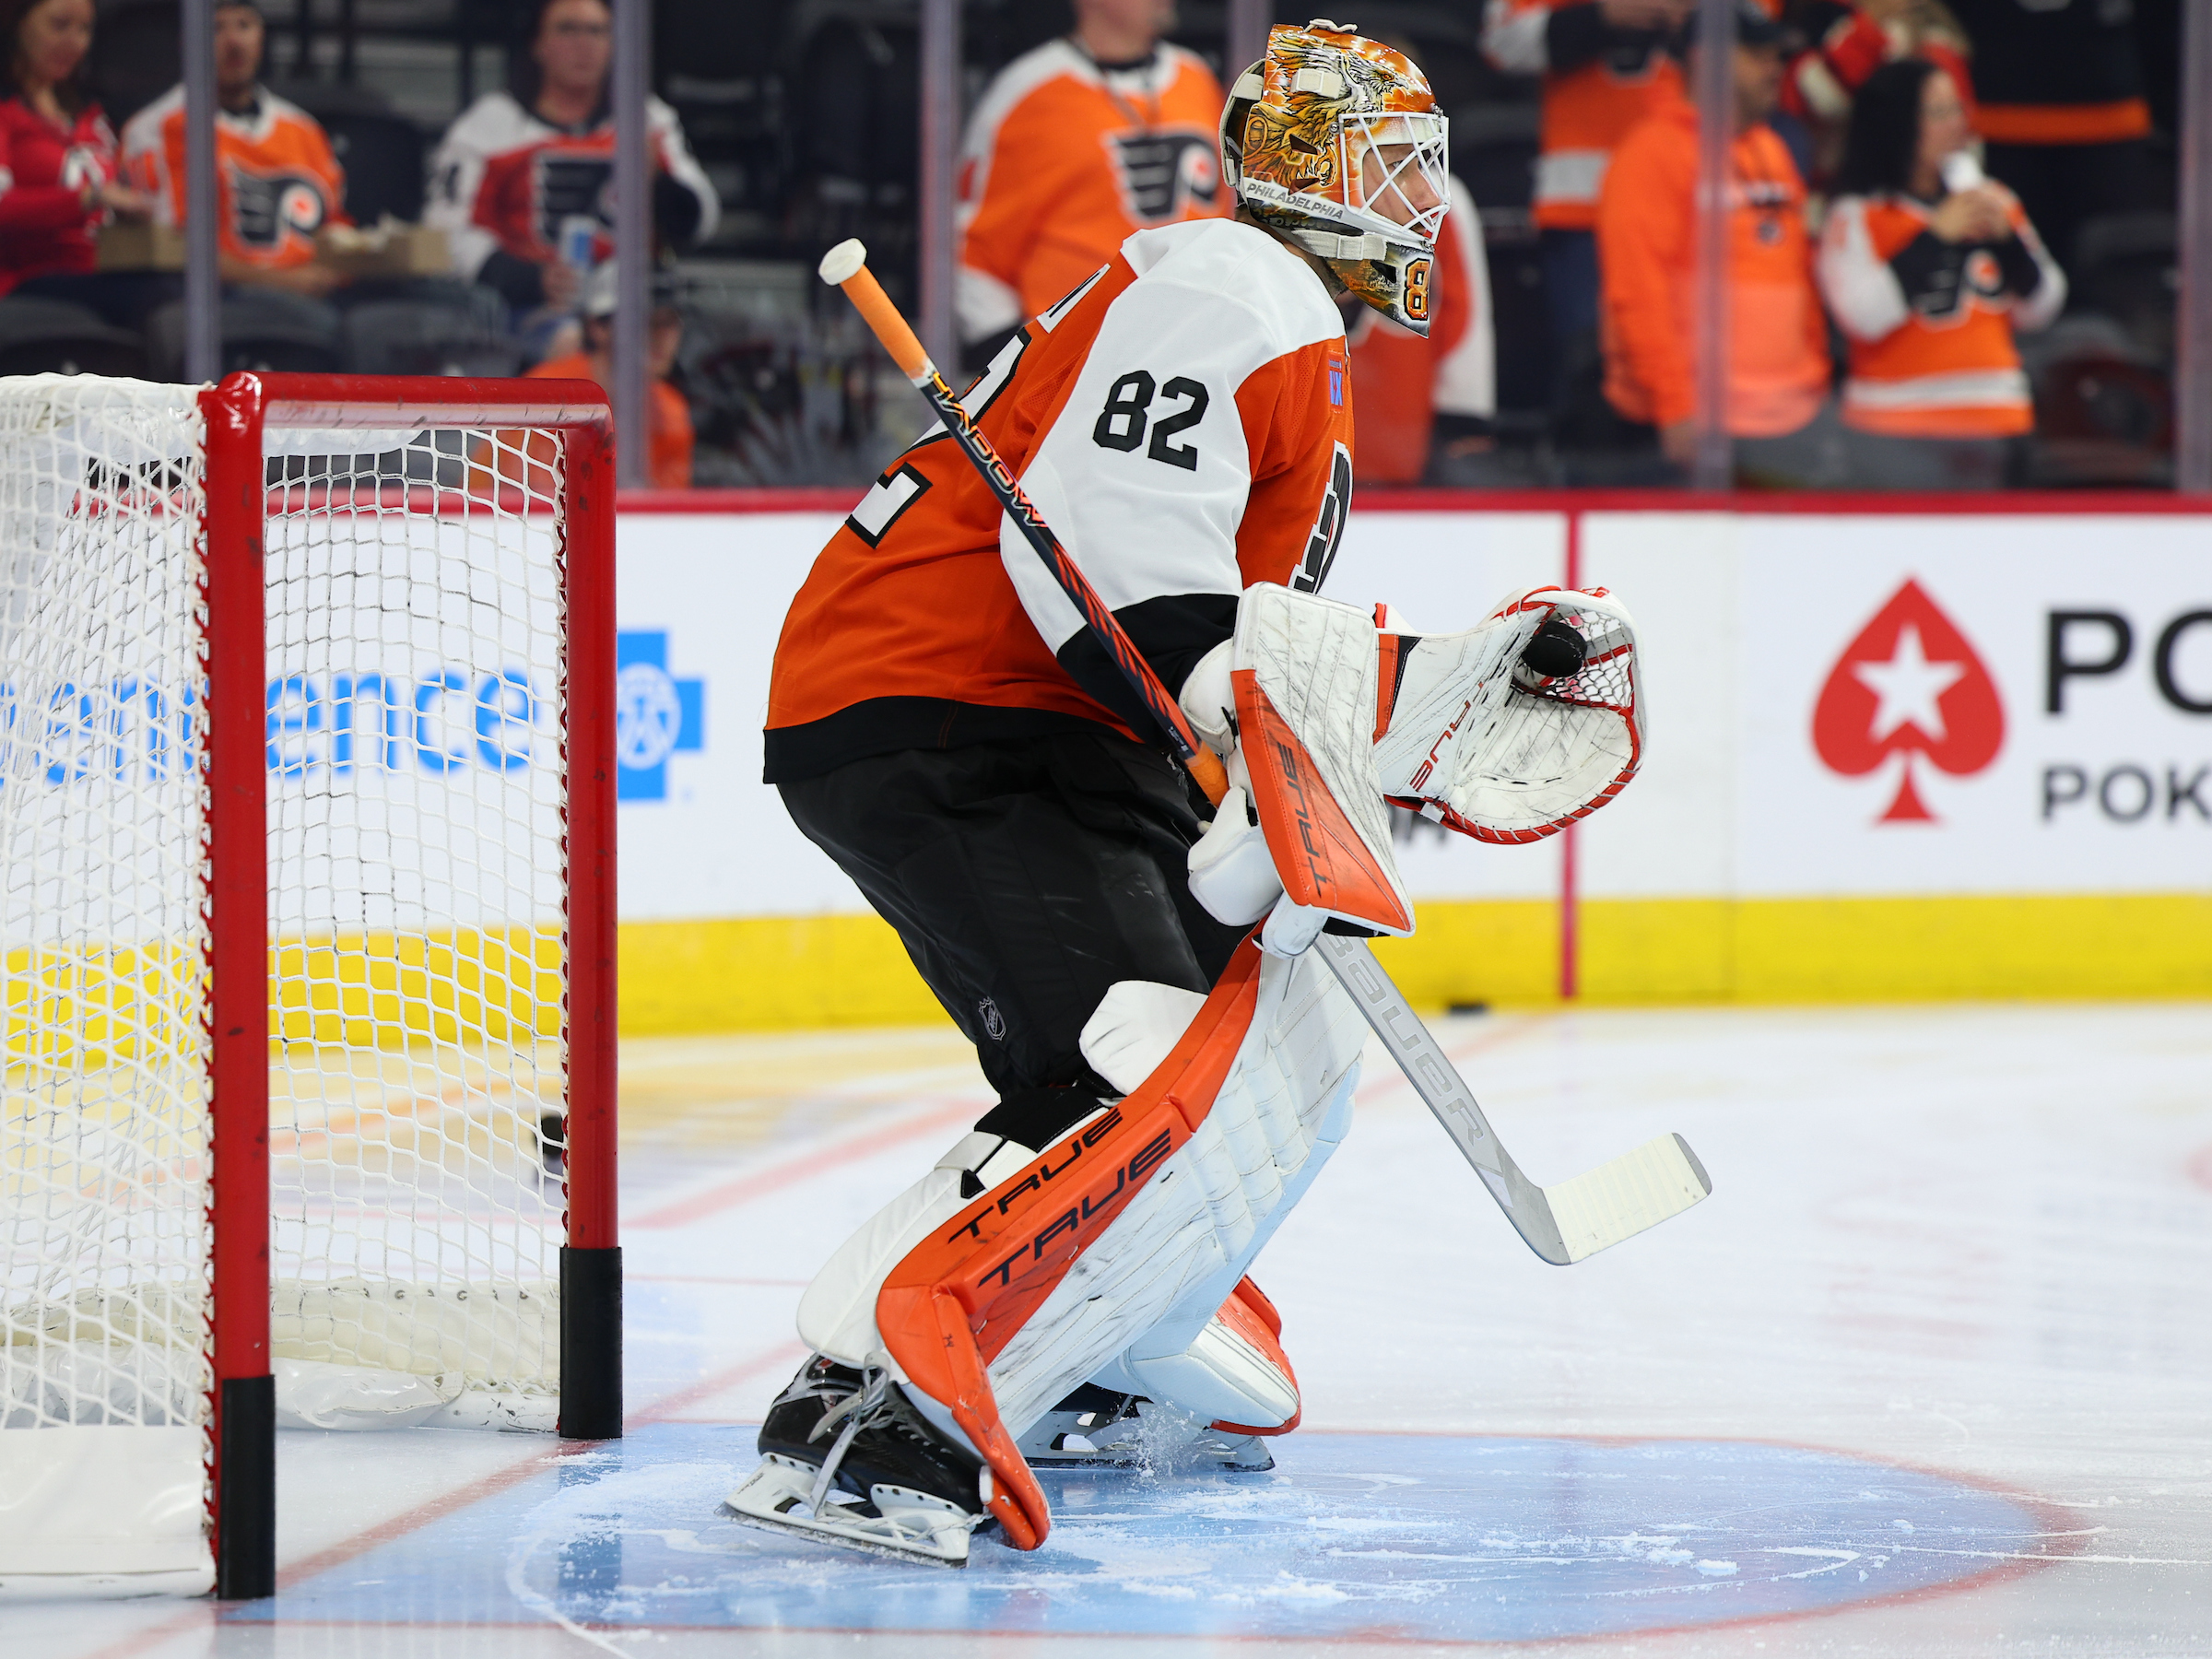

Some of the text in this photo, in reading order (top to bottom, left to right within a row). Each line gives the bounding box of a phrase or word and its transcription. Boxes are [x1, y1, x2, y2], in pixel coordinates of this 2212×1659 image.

[1246, 182, 1345, 219] PHILADELPHIA
[1092, 370, 1209, 472] 82
[1277, 741, 1327, 899] TRUE
[2042, 765, 2212, 823] POK
[947, 1107, 1124, 1244] TRUE
[977, 1127, 1171, 1289] TRUE
